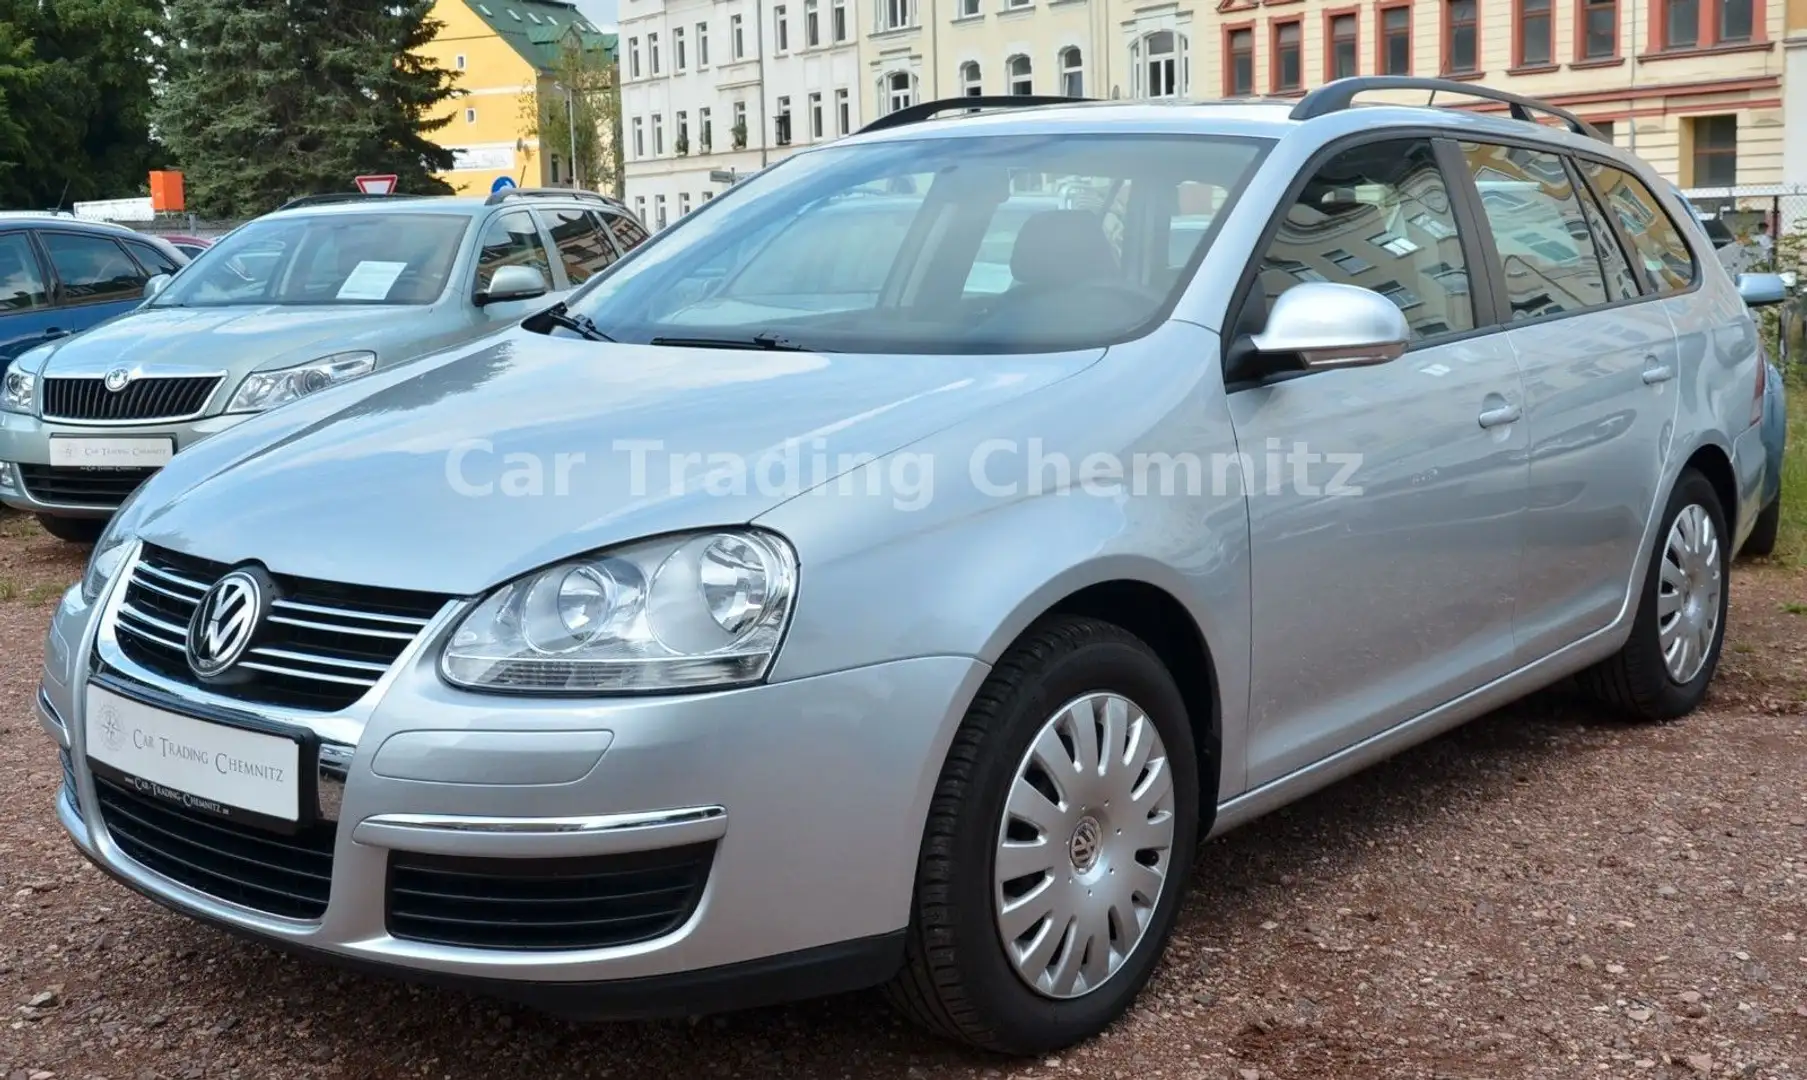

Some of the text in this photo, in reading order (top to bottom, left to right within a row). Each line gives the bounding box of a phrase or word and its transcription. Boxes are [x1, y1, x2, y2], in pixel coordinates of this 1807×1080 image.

[132, 729, 284, 783] CAR TRADING CHEMNITZ
